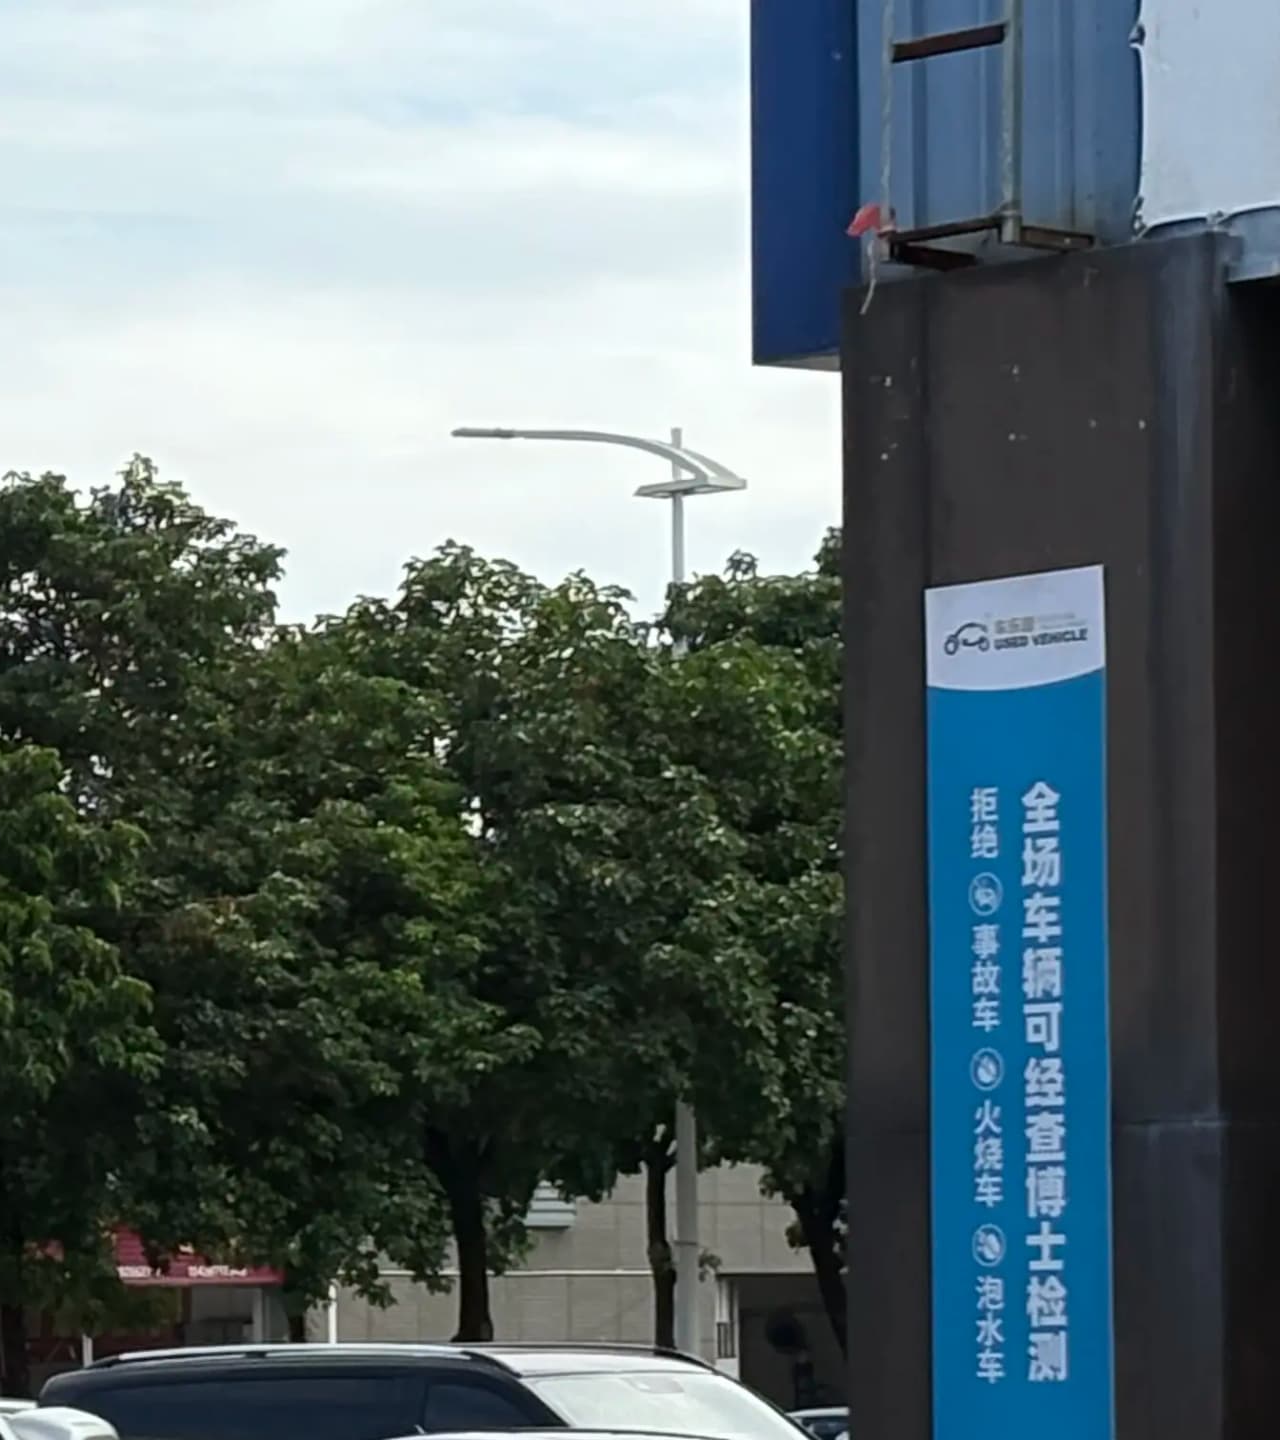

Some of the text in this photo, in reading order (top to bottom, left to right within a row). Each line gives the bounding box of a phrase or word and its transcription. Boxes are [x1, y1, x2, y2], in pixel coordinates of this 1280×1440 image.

[970, 786, 1006, 1384] 拒绝 事故车 火烧车 泡水车
[1021, 781, 1068, 1382] 全场车辆可经查博士检测
